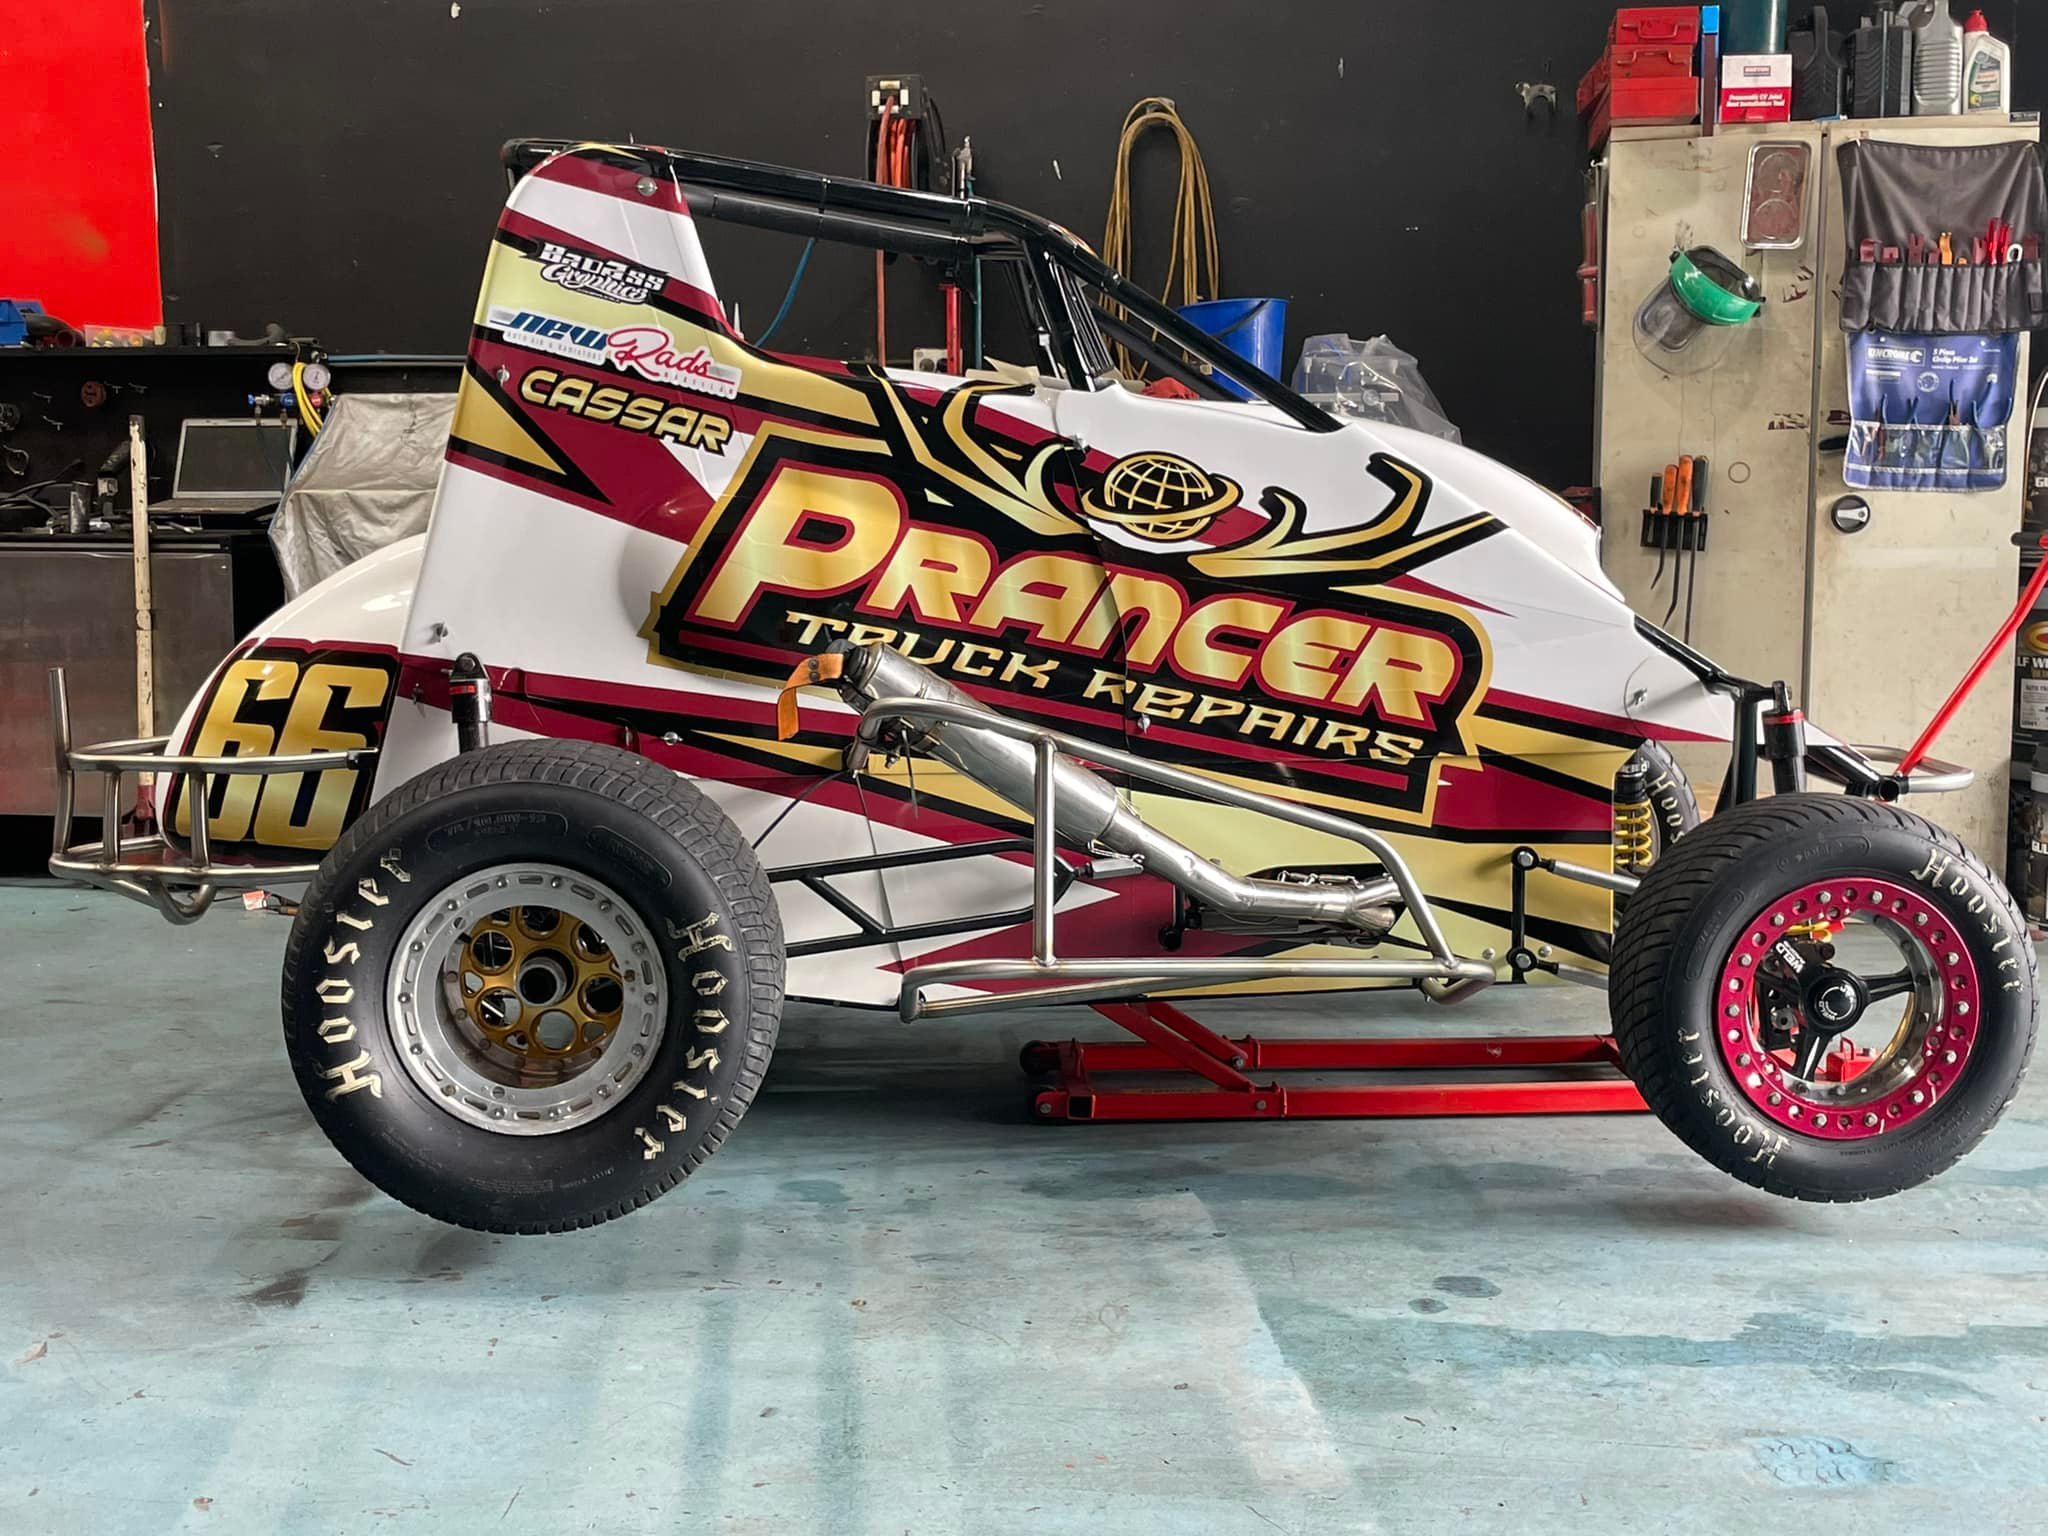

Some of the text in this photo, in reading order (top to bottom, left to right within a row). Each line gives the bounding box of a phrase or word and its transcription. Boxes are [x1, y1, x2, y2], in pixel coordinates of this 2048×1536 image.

[607, 327, 722, 380] Rads
[520, 369, 731, 453] CASSAR
[688, 462, 1455, 724] PRANCER
[175, 658, 389, 851] 66
[1082, 668, 1424, 765] REPAIRS
[1646, 771, 1686, 844] Hoos
[1775, 942, 1804, 974] WELD
